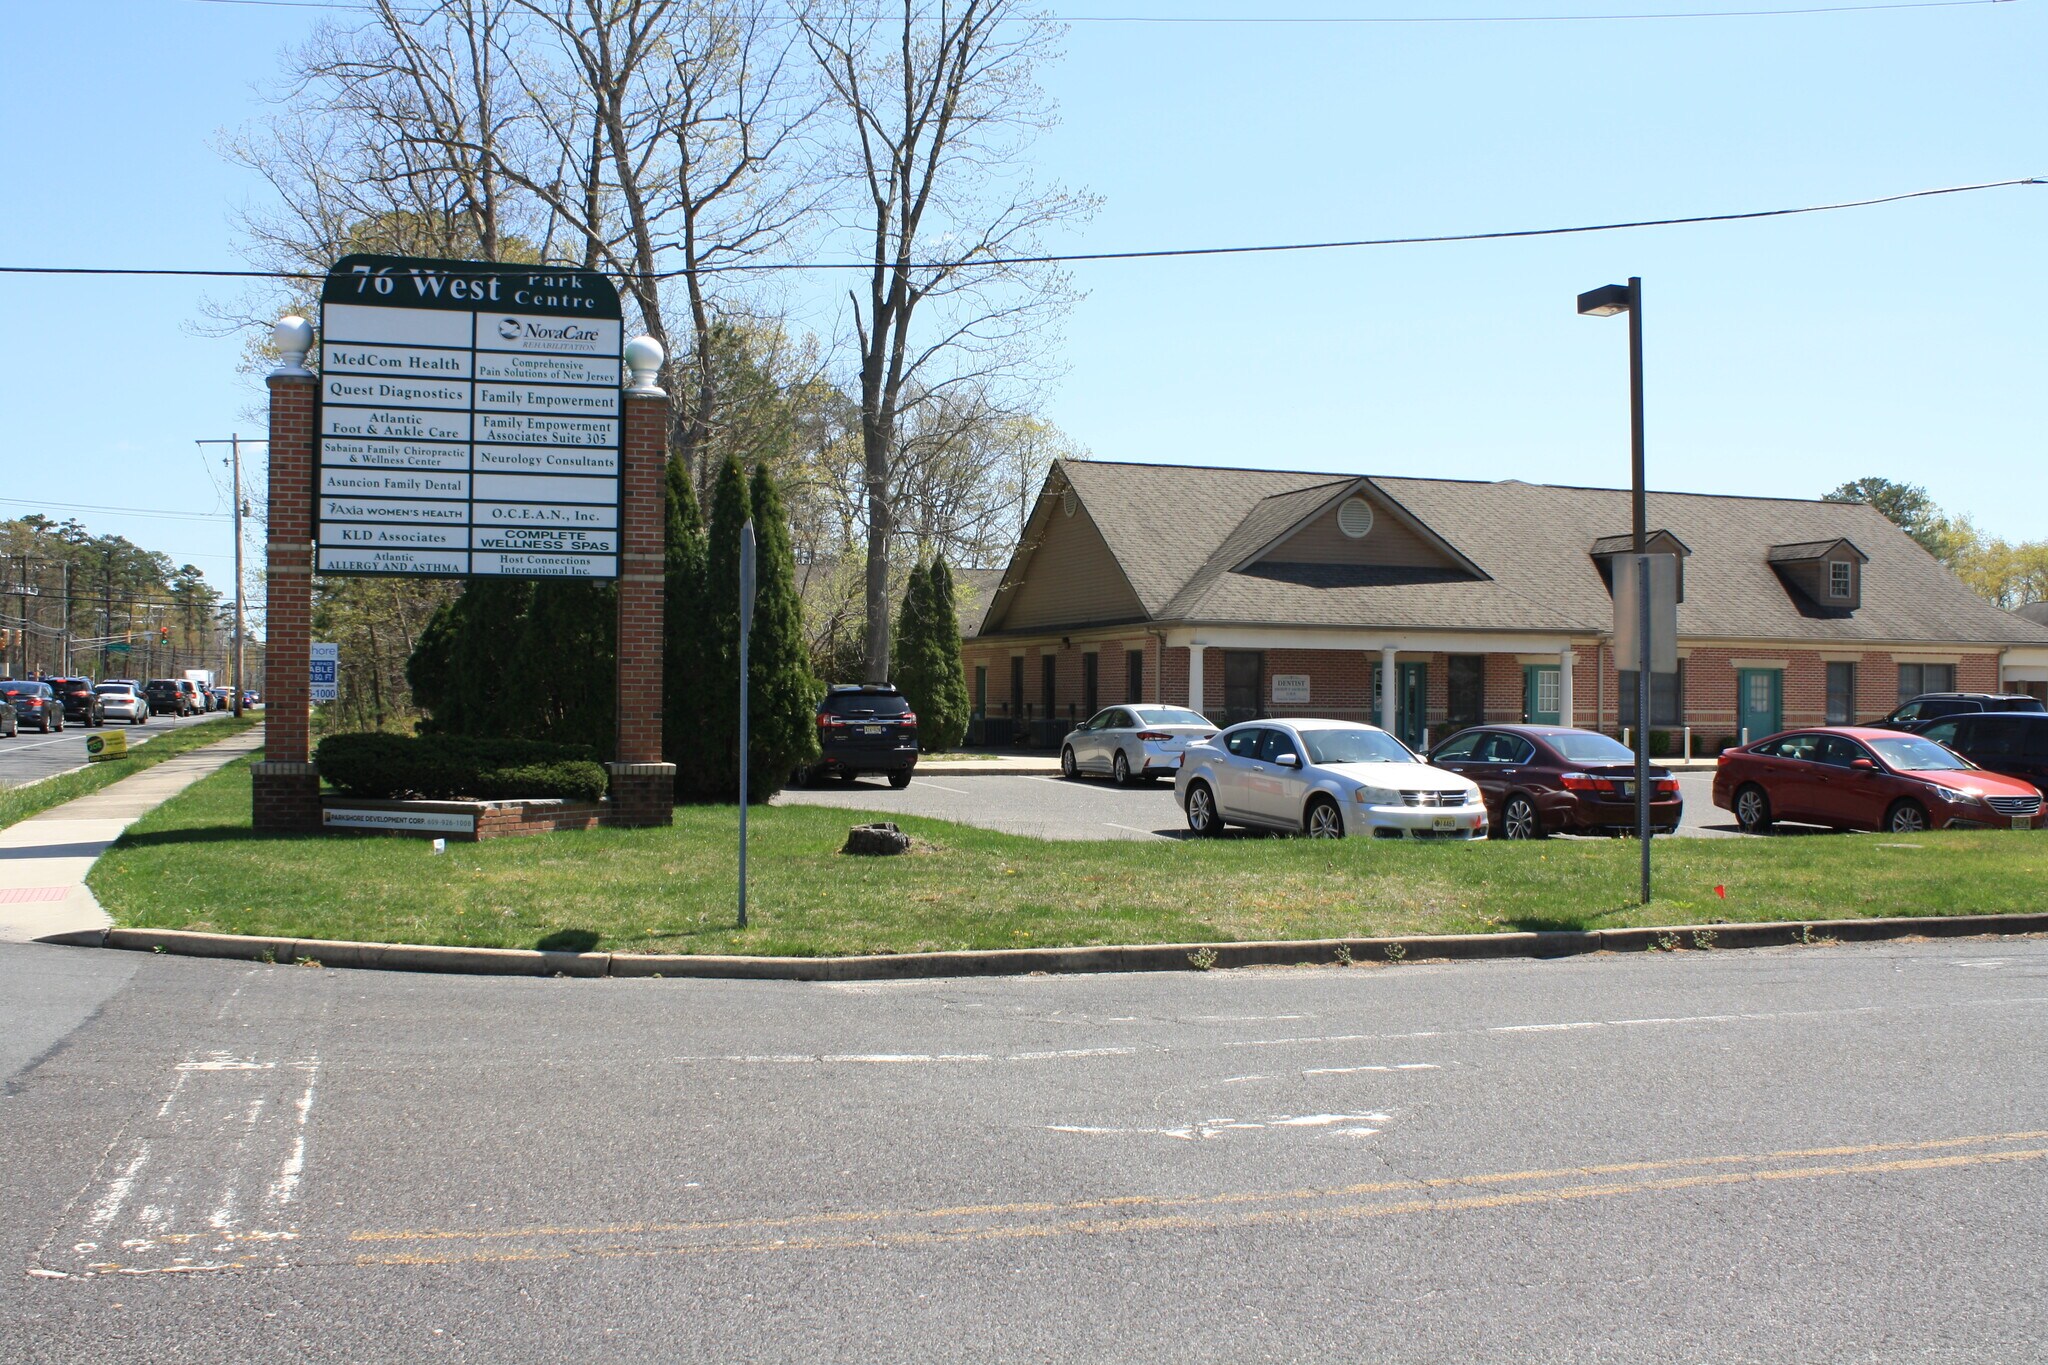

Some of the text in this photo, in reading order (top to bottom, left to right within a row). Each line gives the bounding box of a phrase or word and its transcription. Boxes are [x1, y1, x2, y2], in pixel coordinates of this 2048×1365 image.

[352, 265, 500, 300] 76 West
[528, 275, 583, 289] Park
[514, 290, 594, 308] Centre
[524, 322, 599, 342] NovaCare
[522, 341, 596, 352] REHABILITATION
[332, 352, 461, 371] MedCom Health
[511, 357, 584, 371] Comprehensive
[479, 366, 615, 384] Pain Solutions of New Jersey
[330, 382, 463, 401] Quest Diagnostics
[481, 390, 614, 408] Family Empowerment
[368, 413, 423, 425] Atlantic
[483, 416, 611, 433] Family Empowerment
[332, 422, 459, 439] Foot & Ankle Care
[486, 429, 607, 445] Associates Suite 305
[324, 443, 465, 460] Sabaina Family Chiropractic
[349, 454, 441, 467] & Wellness Center
[481, 452, 614, 468] Neurology Consultants
[327, 476, 462, 491] Asuncion Family Dental
[336, 505, 463, 518] Axia WOMEN'S HEALTH
[575, 509, 600, 521] Inc.
[342, 529, 447, 543] KLD Associates
[504, 530, 586, 541] COMPLETE
[481, 539, 609, 550] WELLNESS SPAS
[374, 551, 414, 562] Atlantic
[500, 555, 591, 565] Host Connections
[327, 560, 459, 572] ALLERGY AND ASTHMA
[500, 564, 591, 575] International Inc.
[311, 646, 336, 656] hore
[310, 666, 333, 674] ABLE
[331, 814, 365, 822] PARKSHORE
[365, 815, 408, 824] DEVELOPMENT
[408, 817, 426, 825] CORP.
